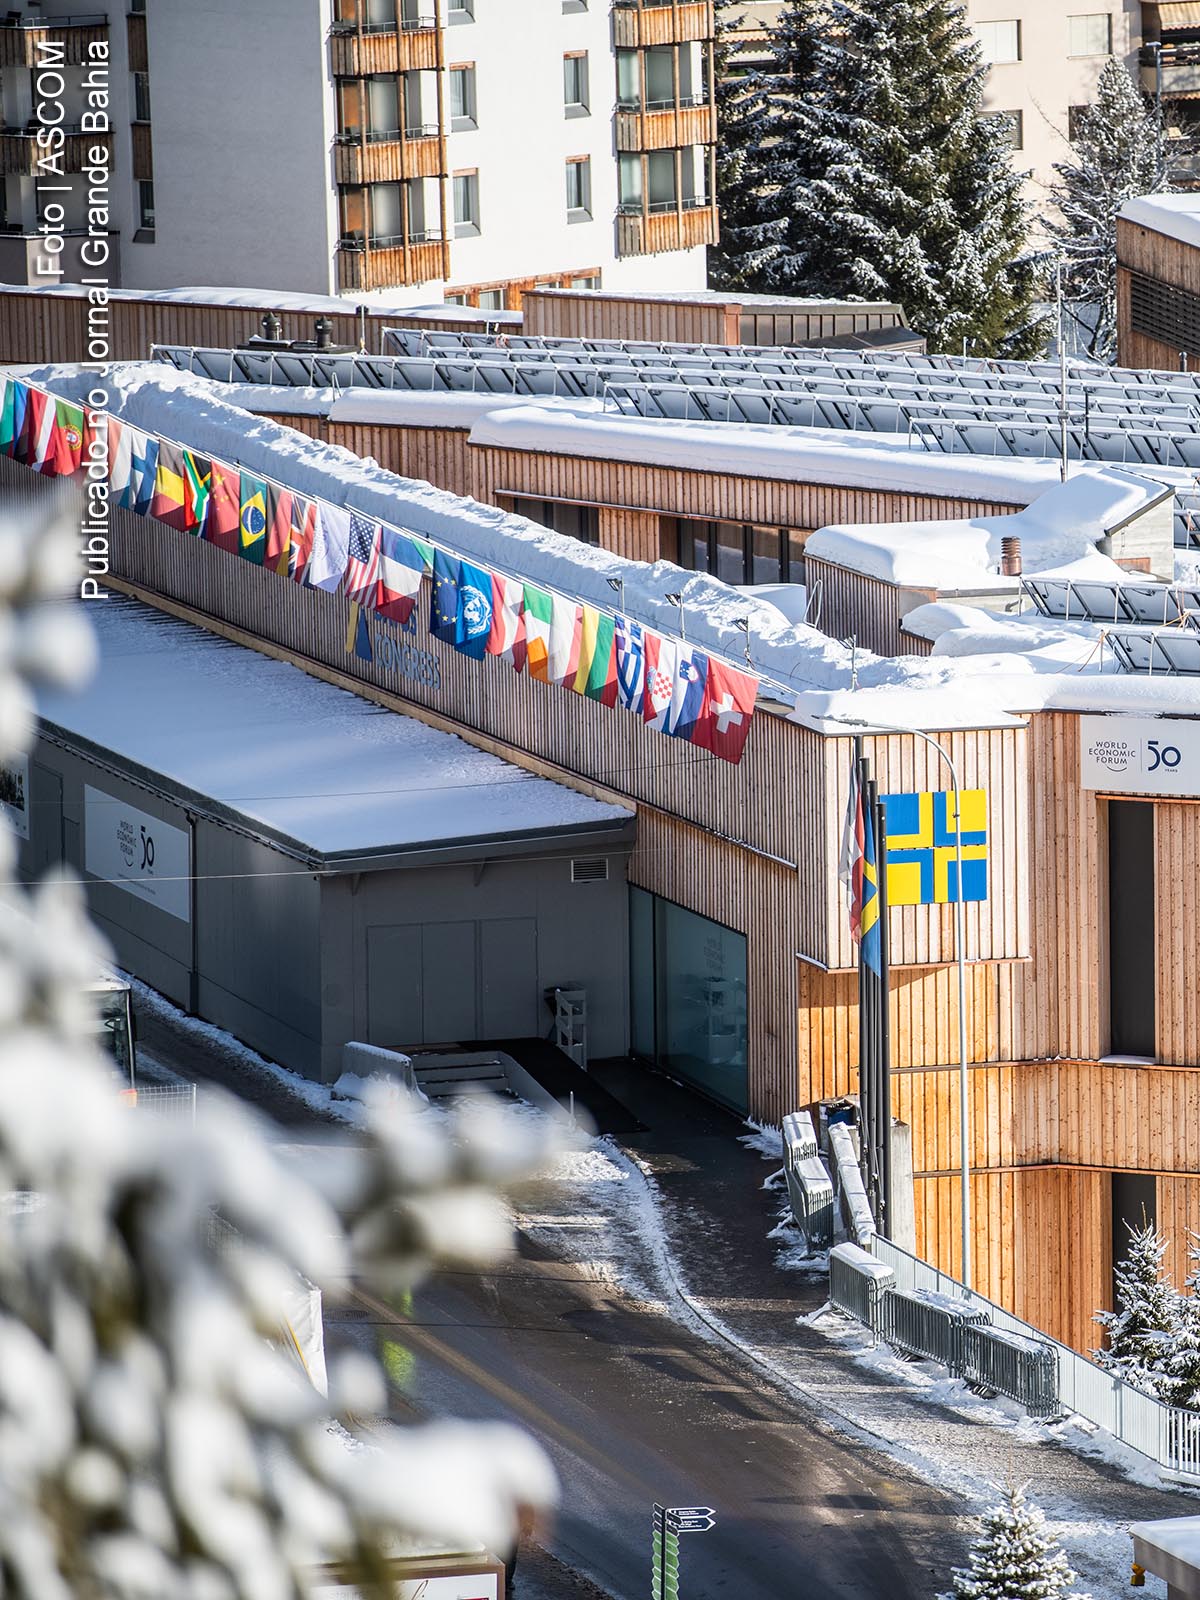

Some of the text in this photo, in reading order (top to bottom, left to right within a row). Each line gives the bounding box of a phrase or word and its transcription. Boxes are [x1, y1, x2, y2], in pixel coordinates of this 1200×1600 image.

[374, 632, 441, 691] CONGRESS
[1095, 741, 1128, 750] WORLD
[1088, 748, 1136, 758] ECONOMIC
[1147, 740, 1181, 772] 50
[1096, 756, 1128, 765] FORUM
